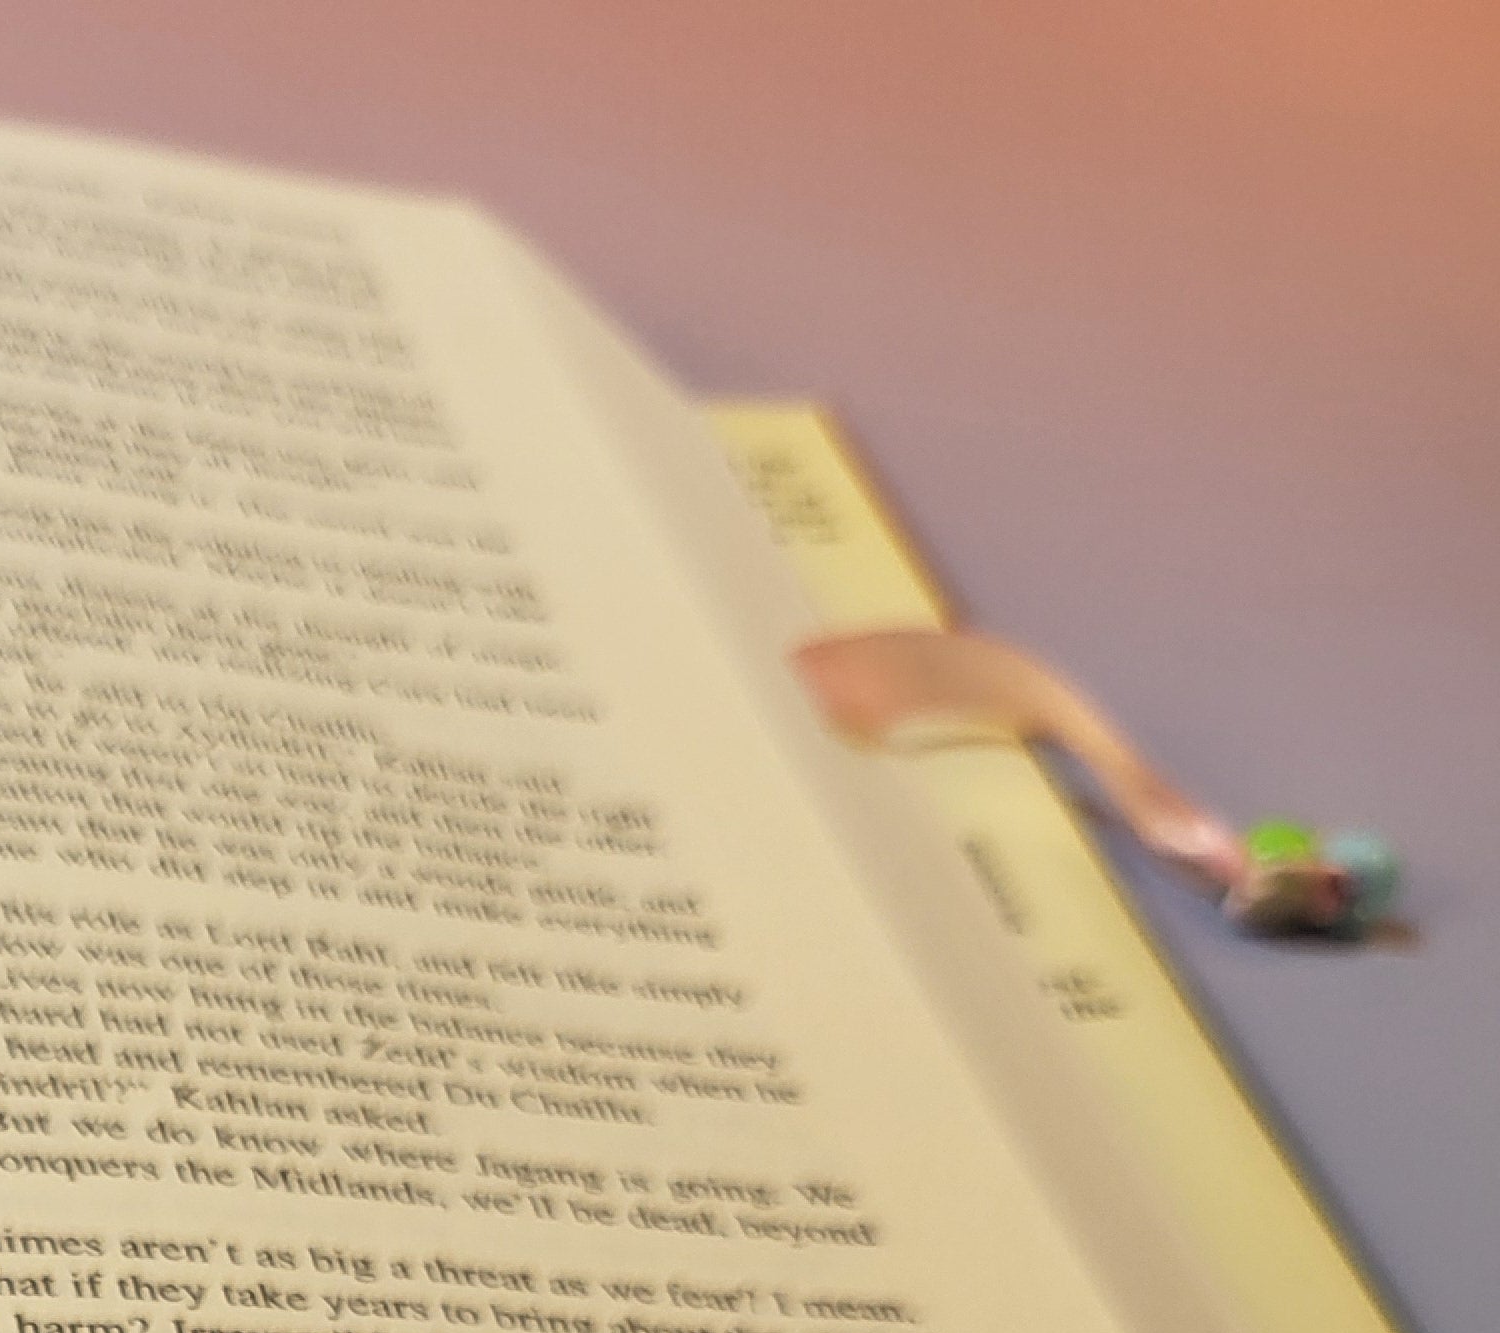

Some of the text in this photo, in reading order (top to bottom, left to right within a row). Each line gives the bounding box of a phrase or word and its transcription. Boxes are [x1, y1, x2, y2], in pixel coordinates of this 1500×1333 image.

[71, 1268, 103, 1299] if
[116, 1273, 207, 1312] they
[221, 1281, 309, 1311] take
[322, 1292, 430, 1322] years
[439, 1300, 483, 1326] to
[119, 1236, 241, 1266] aren't
[255, 1246, 297, 1271] as
[307, 1245, 377, 1284] big
[389, 1258, 413, 1281] a
[423, 1255, 538, 1293] threat
[548, 1274, 590, 1298] as
[601, 1279, 657, 1306] we
